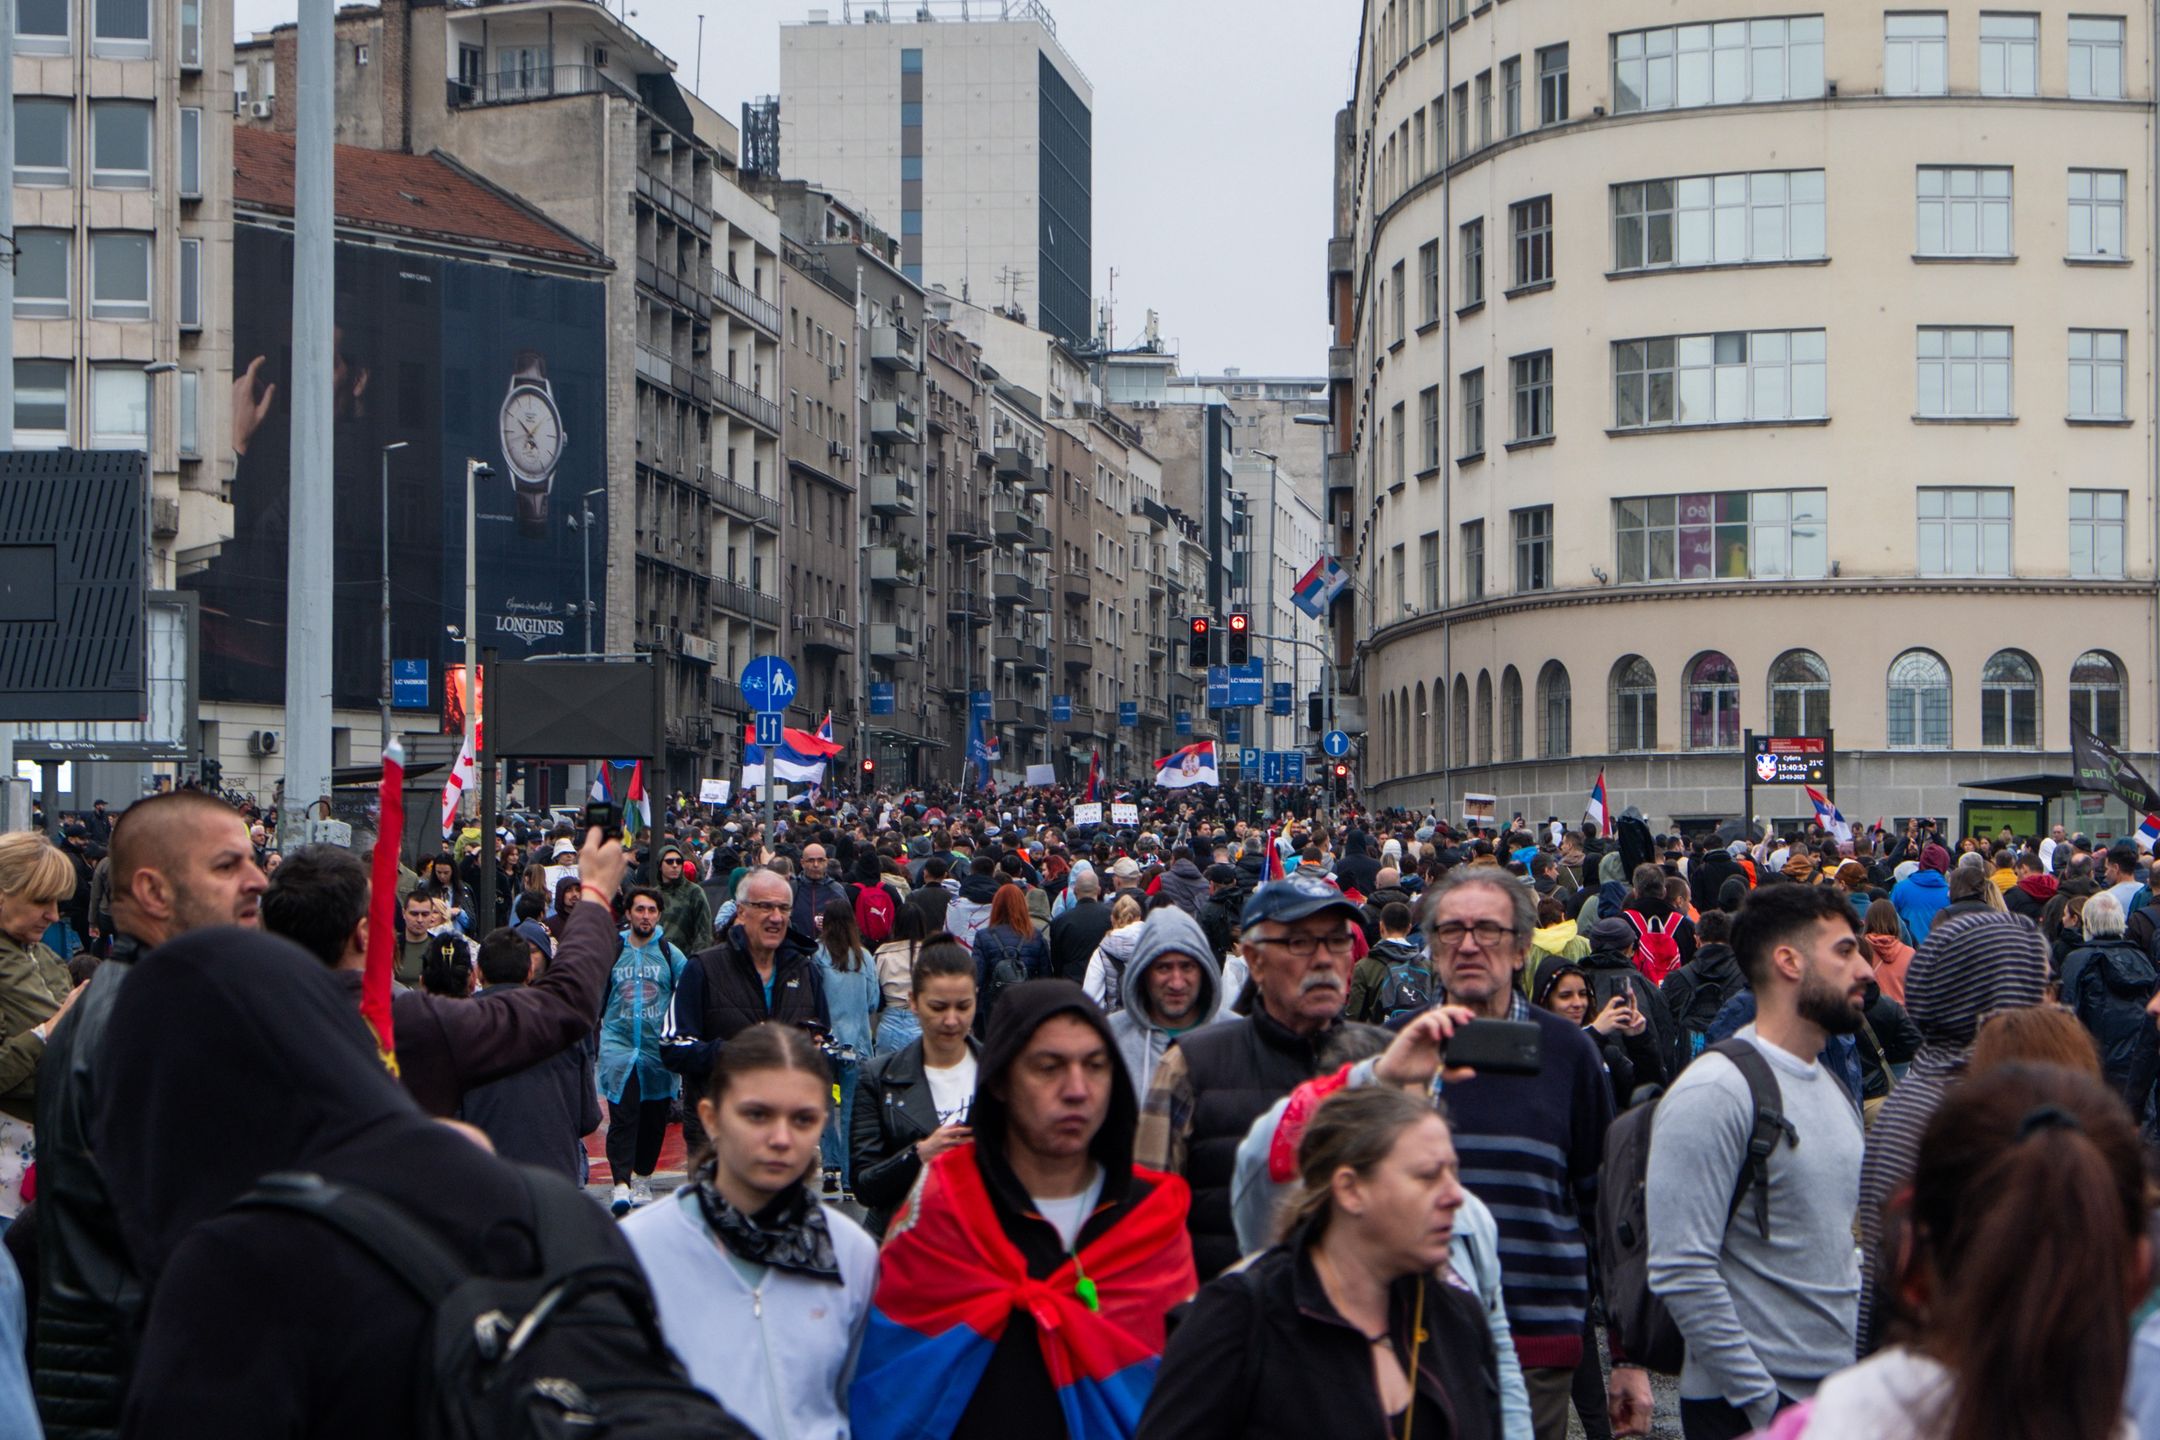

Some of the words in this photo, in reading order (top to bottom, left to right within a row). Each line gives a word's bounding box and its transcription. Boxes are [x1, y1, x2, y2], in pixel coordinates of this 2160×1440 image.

[495, 615, 564, 636] LONGINES
[1244, 750, 1256, 766] P
[1809, 759, 1824, 767] 21°C
[1778, 763, 1808, 772] 15:40:52
[612, 965, 661, 983] RUBY
